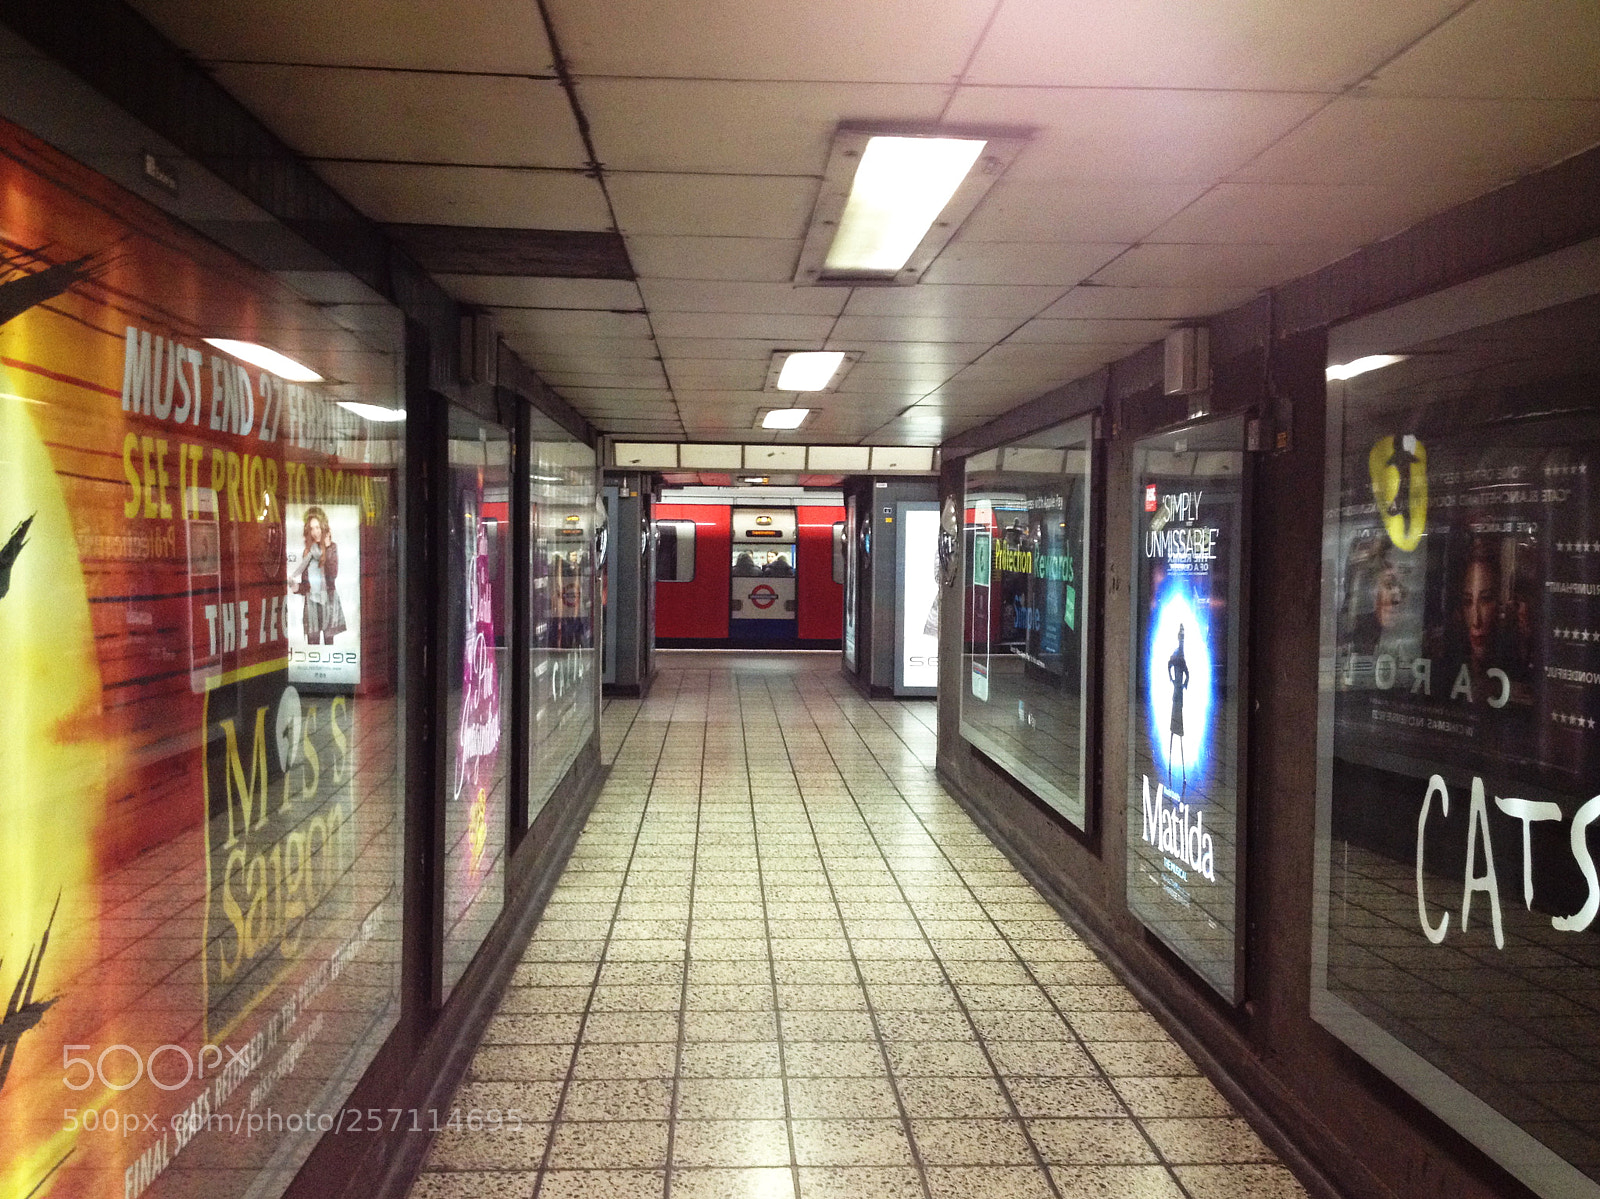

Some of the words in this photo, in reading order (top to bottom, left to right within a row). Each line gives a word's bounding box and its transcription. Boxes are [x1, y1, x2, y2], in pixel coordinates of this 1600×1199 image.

[121, 326, 203, 426] MUST
[210, 356, 254, 436] END
[258, 373, 283, 443] 27
[123, 432, 172, 519] SEE
[180, 443, 203, 521] IT
[211, 448, 281, 524] PRIOR
[995, 539, 1031, 573] Protection
[1034, 540, 1073, 582] Rewards
[205, 600, 249, 656] THE
[1142, 774, 1215, 883] Matilda
[1416, 773, 1600, 950] CATS
[220, 802, 343, 982] Saigon
[125, 1131, 170, 1199] FINAL
